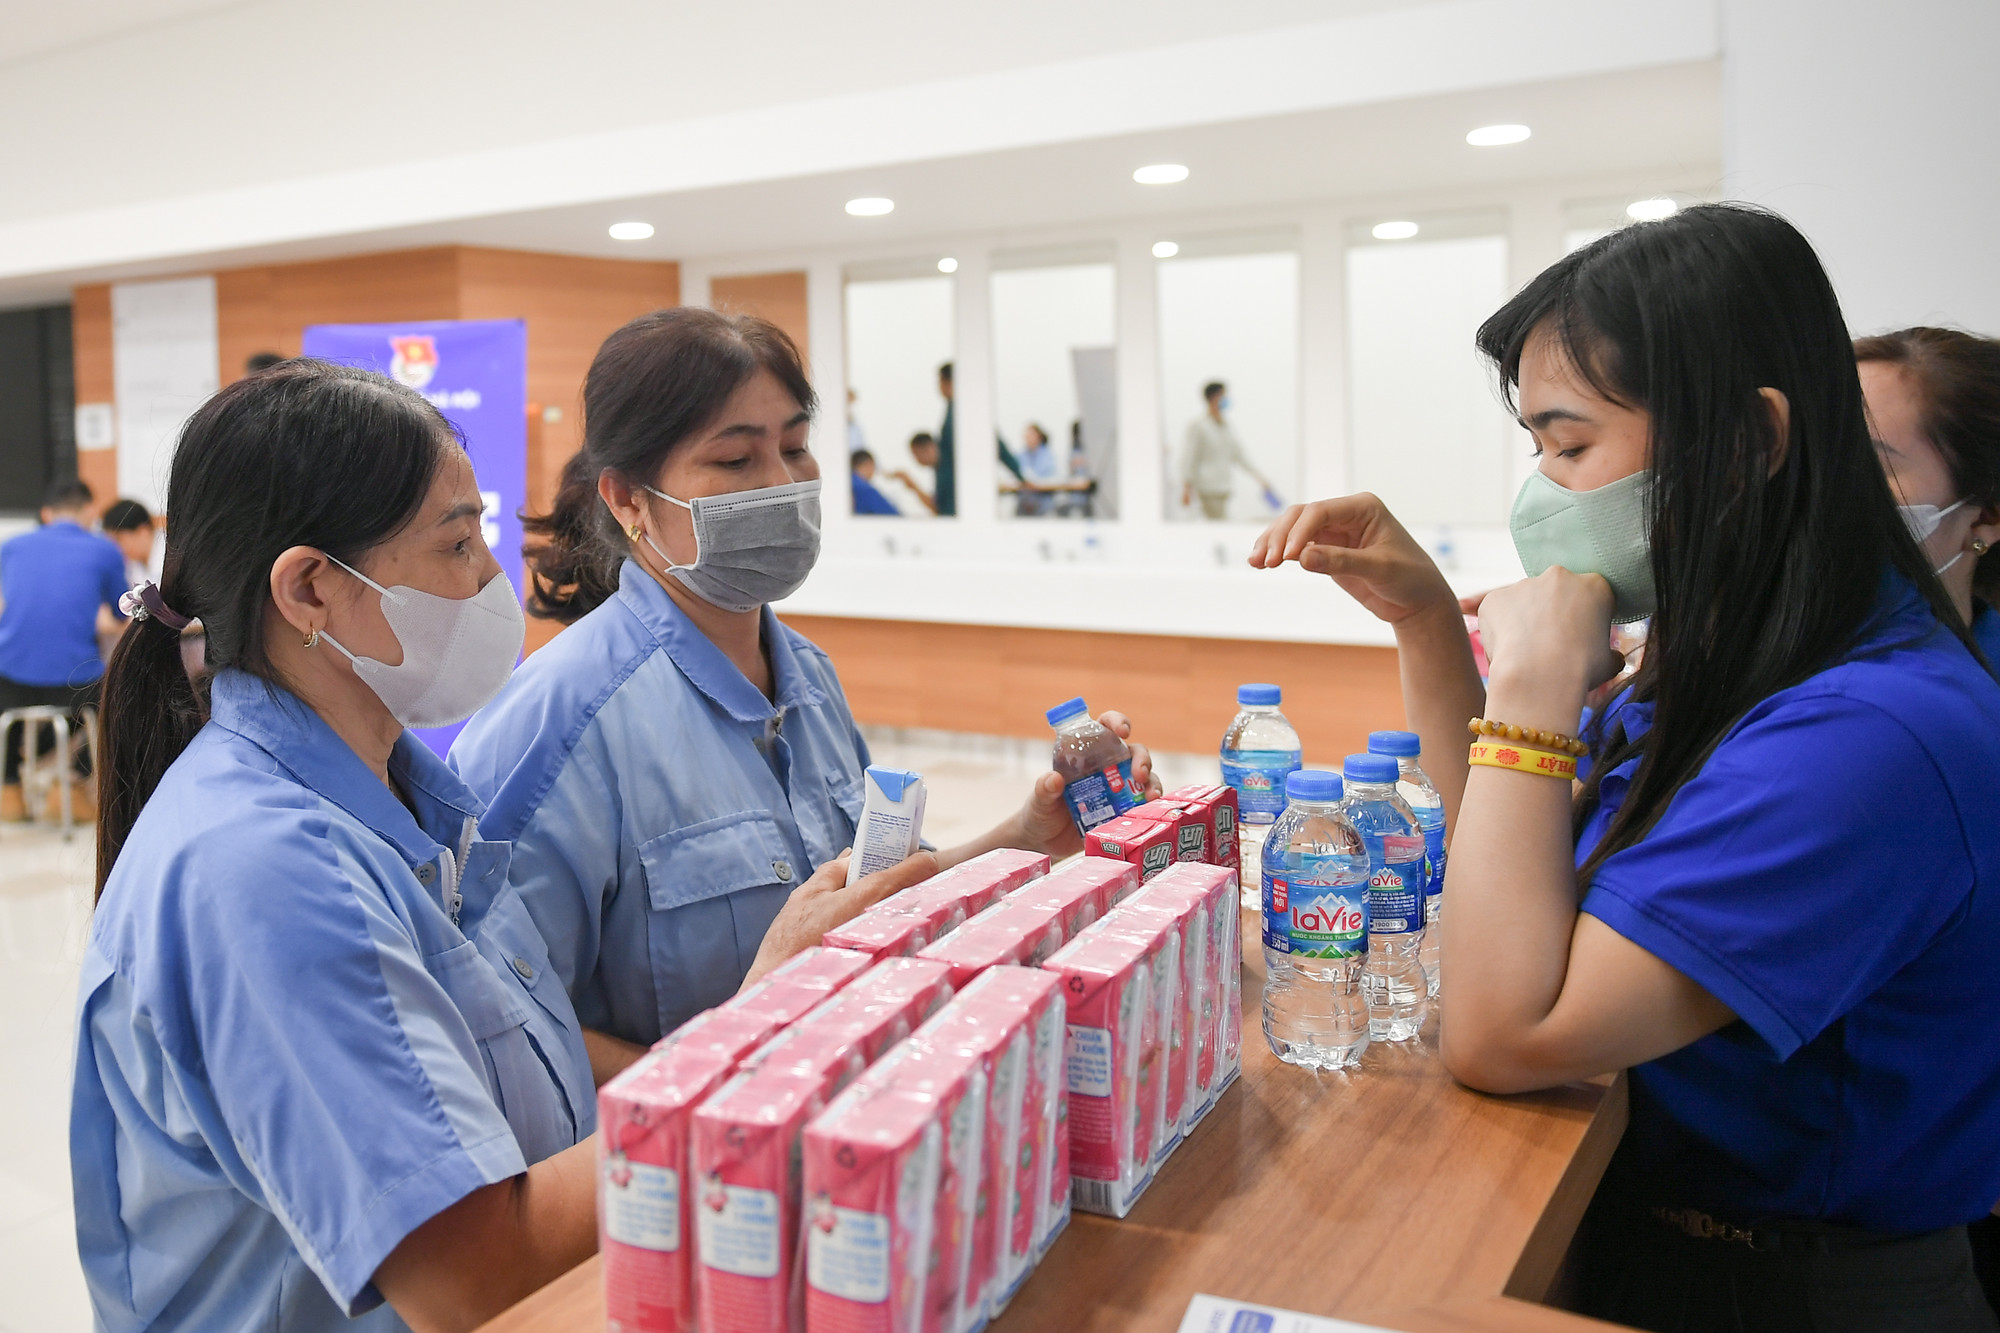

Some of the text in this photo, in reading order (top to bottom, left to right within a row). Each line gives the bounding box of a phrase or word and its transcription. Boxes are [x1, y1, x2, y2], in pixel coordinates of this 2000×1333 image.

[1537, 757, 1575, 773] PHẬT
[1243, 776, 1270, 787] laVie
[1292, 905, 1362, 932] laVie
